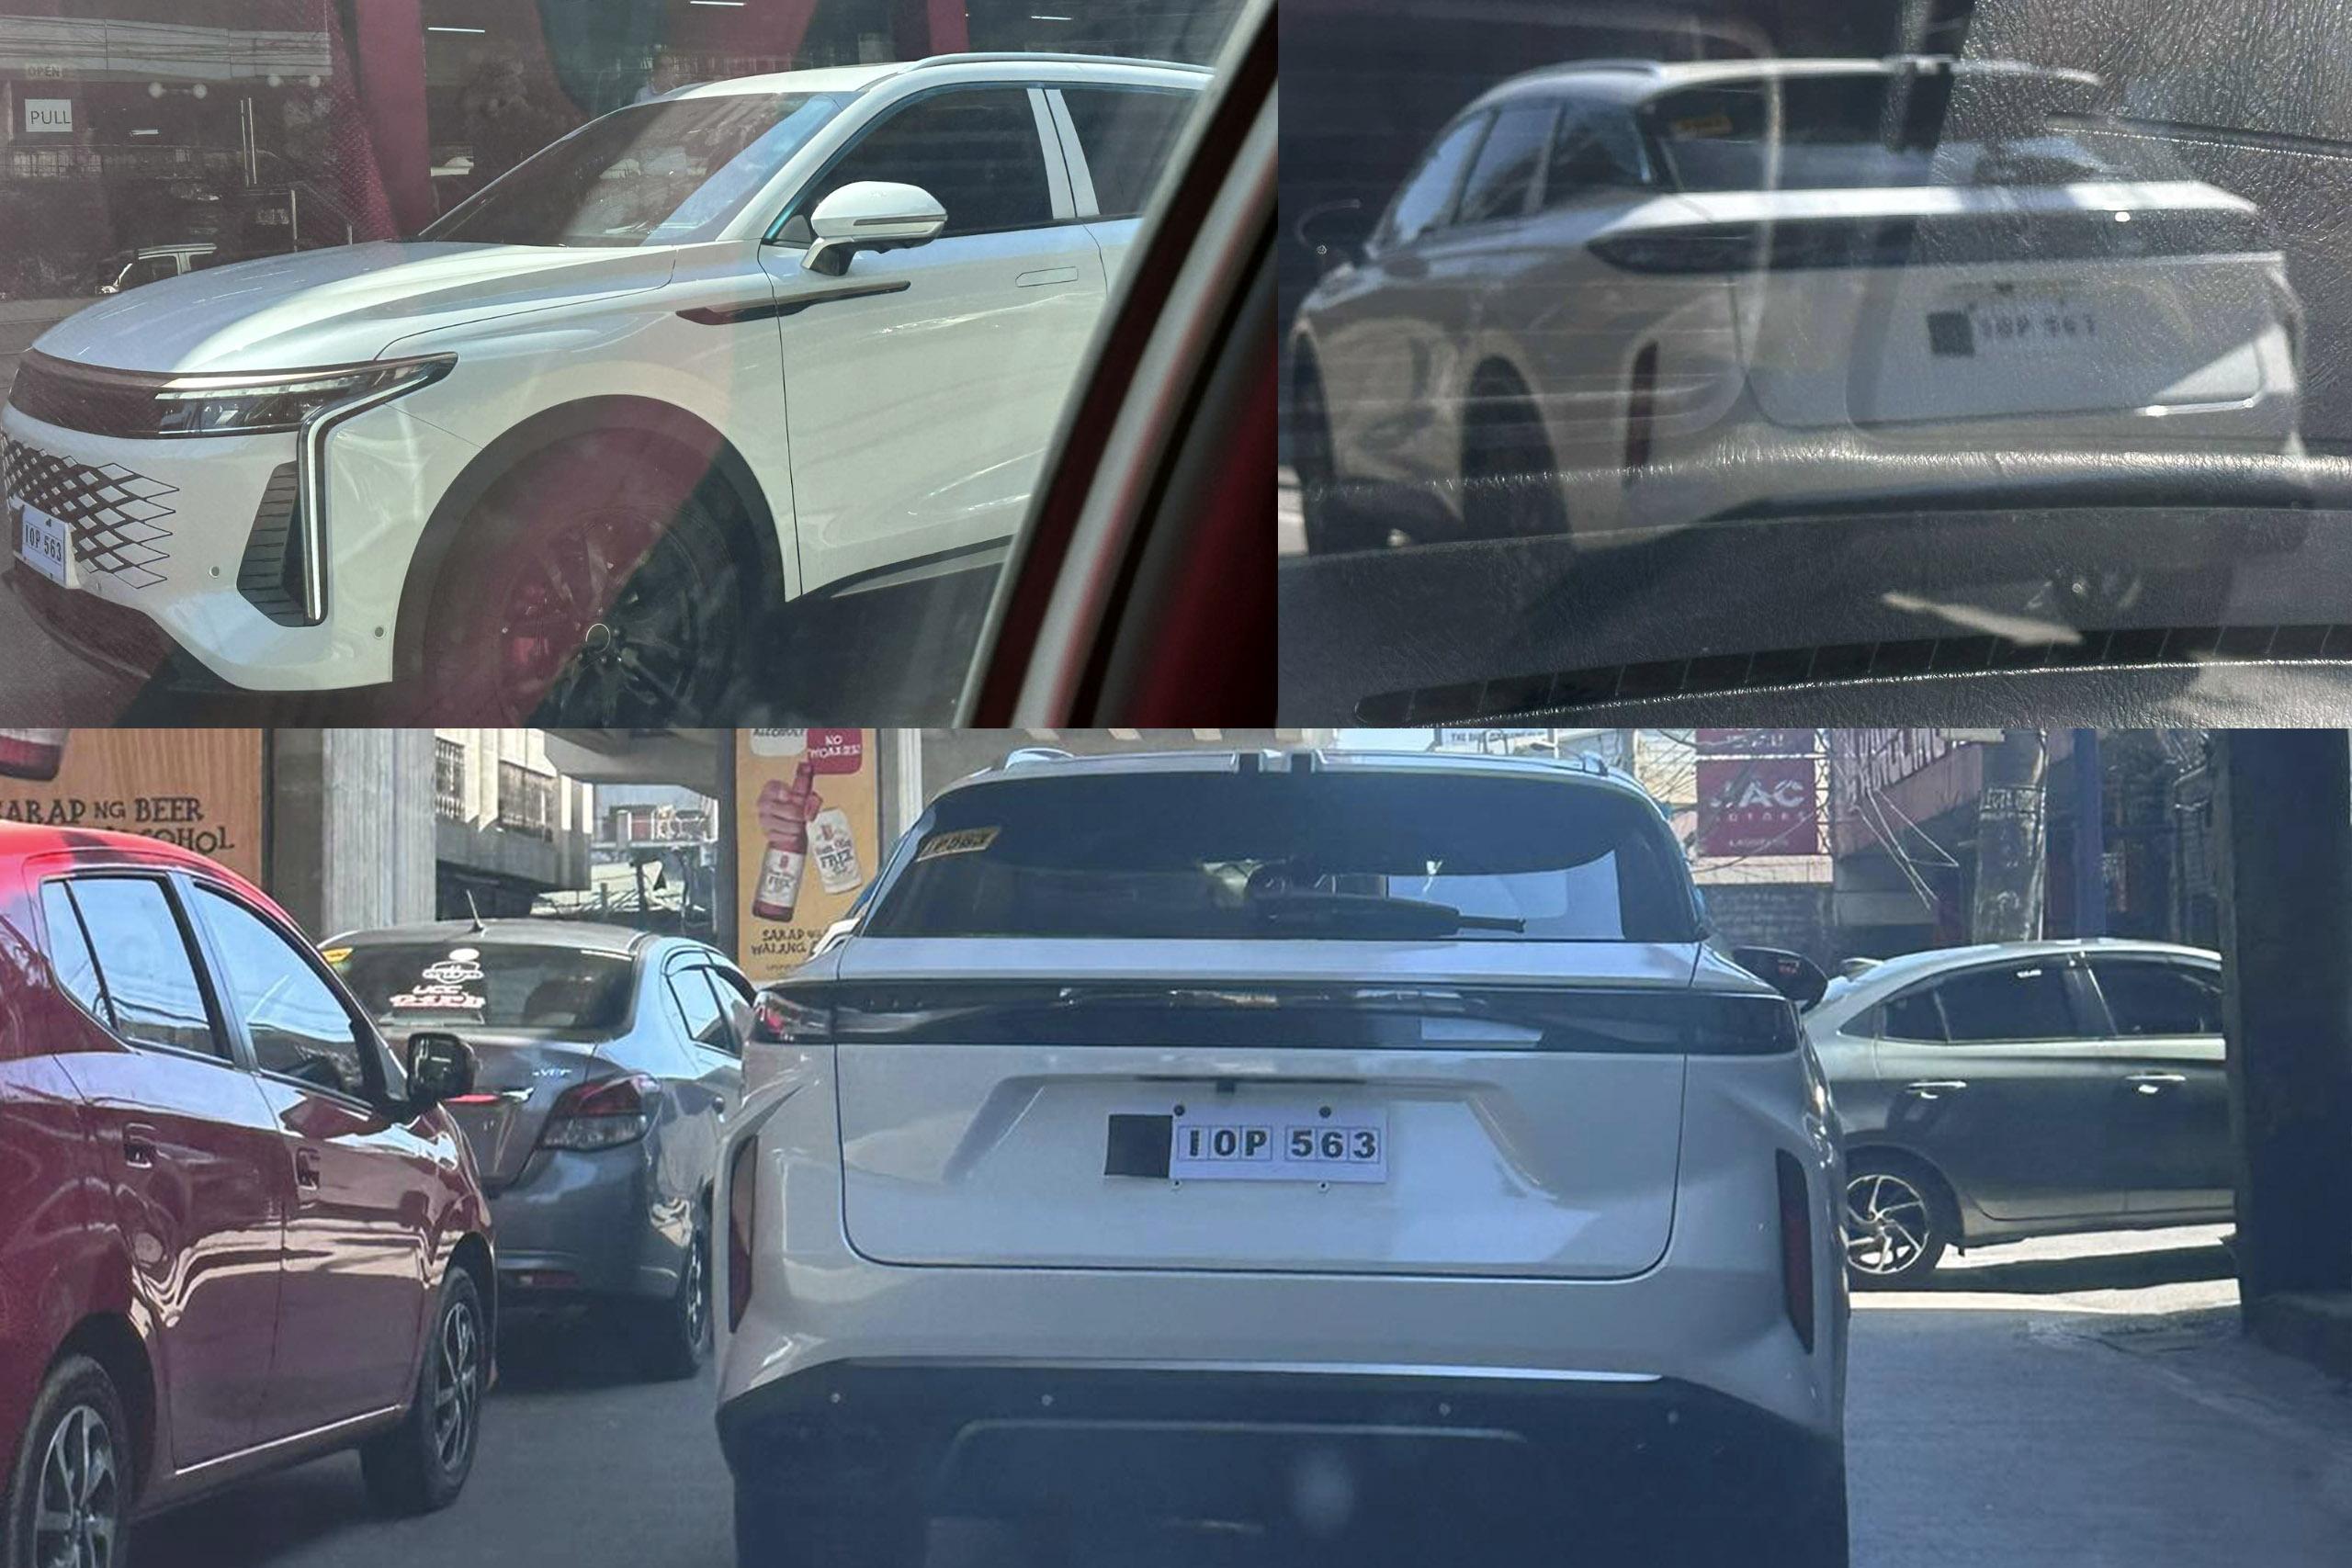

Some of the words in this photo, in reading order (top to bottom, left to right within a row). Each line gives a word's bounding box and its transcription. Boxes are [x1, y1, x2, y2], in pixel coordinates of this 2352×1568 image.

[28, 65, 61, 77] OPEN
[30, 110, 72, 125] PULL
[44, 536, 62, 561] 563
[825, 735, 842, 746] NO
[1711, 779, 1805, 807] JAC
[0, 798, 86, 825] ARAP
[94, 800, 127, 819] NG
[135, 796, 205, 823] BEER
[1291, 1129, 1377, 1159] 563
